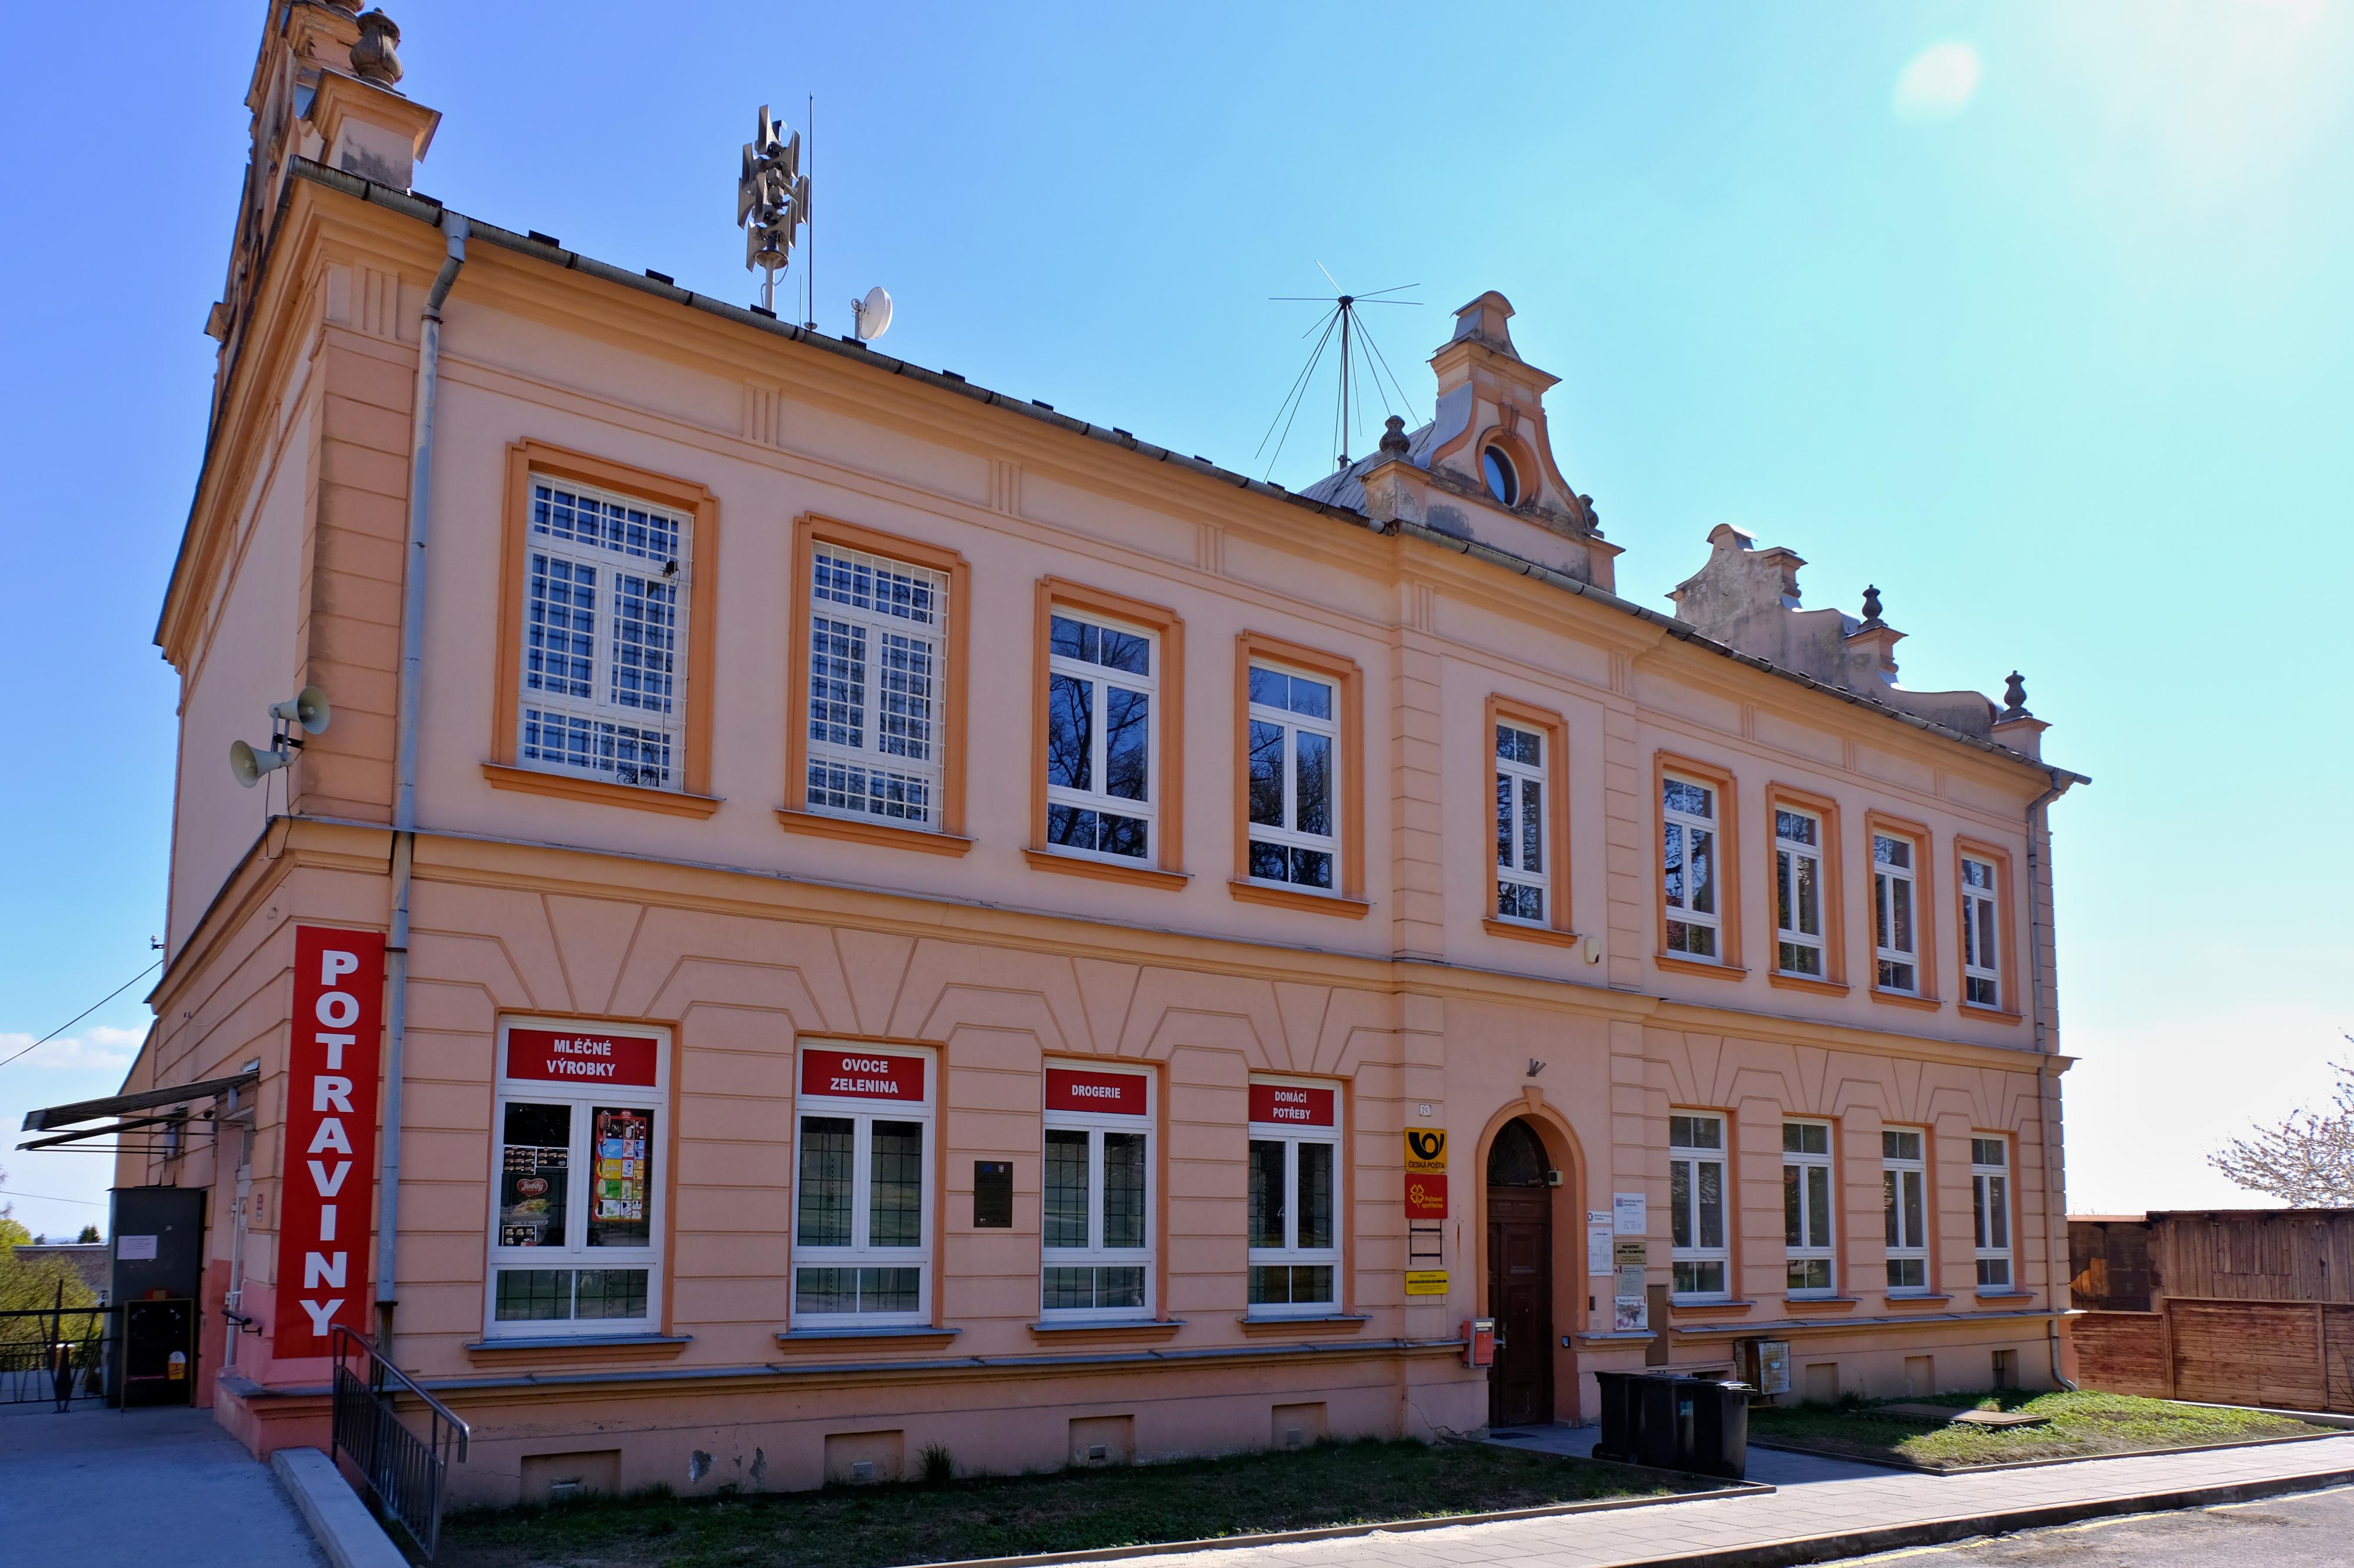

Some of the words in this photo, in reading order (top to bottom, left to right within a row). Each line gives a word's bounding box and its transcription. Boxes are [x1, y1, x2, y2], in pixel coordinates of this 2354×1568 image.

[554, 1038, 611, 1056] MLÉČNÉ
[546, 1057, 616, 1077] VÝROBKY
[842, 1058, 888, 1073] OVOCE
[830, 1077, 899, 1094] ZELENINA
[1072, 1084, 1121, 1098] DROGERIE
[1275, 1090, 1306, 1103] DOMÁCÍ
[1273, 1106, 1311, 1120] POTŘEBY
[299, 950, 360, 1336] POTRAVINY
[1408, 1160, 1427, 1168] ČESKÁ
